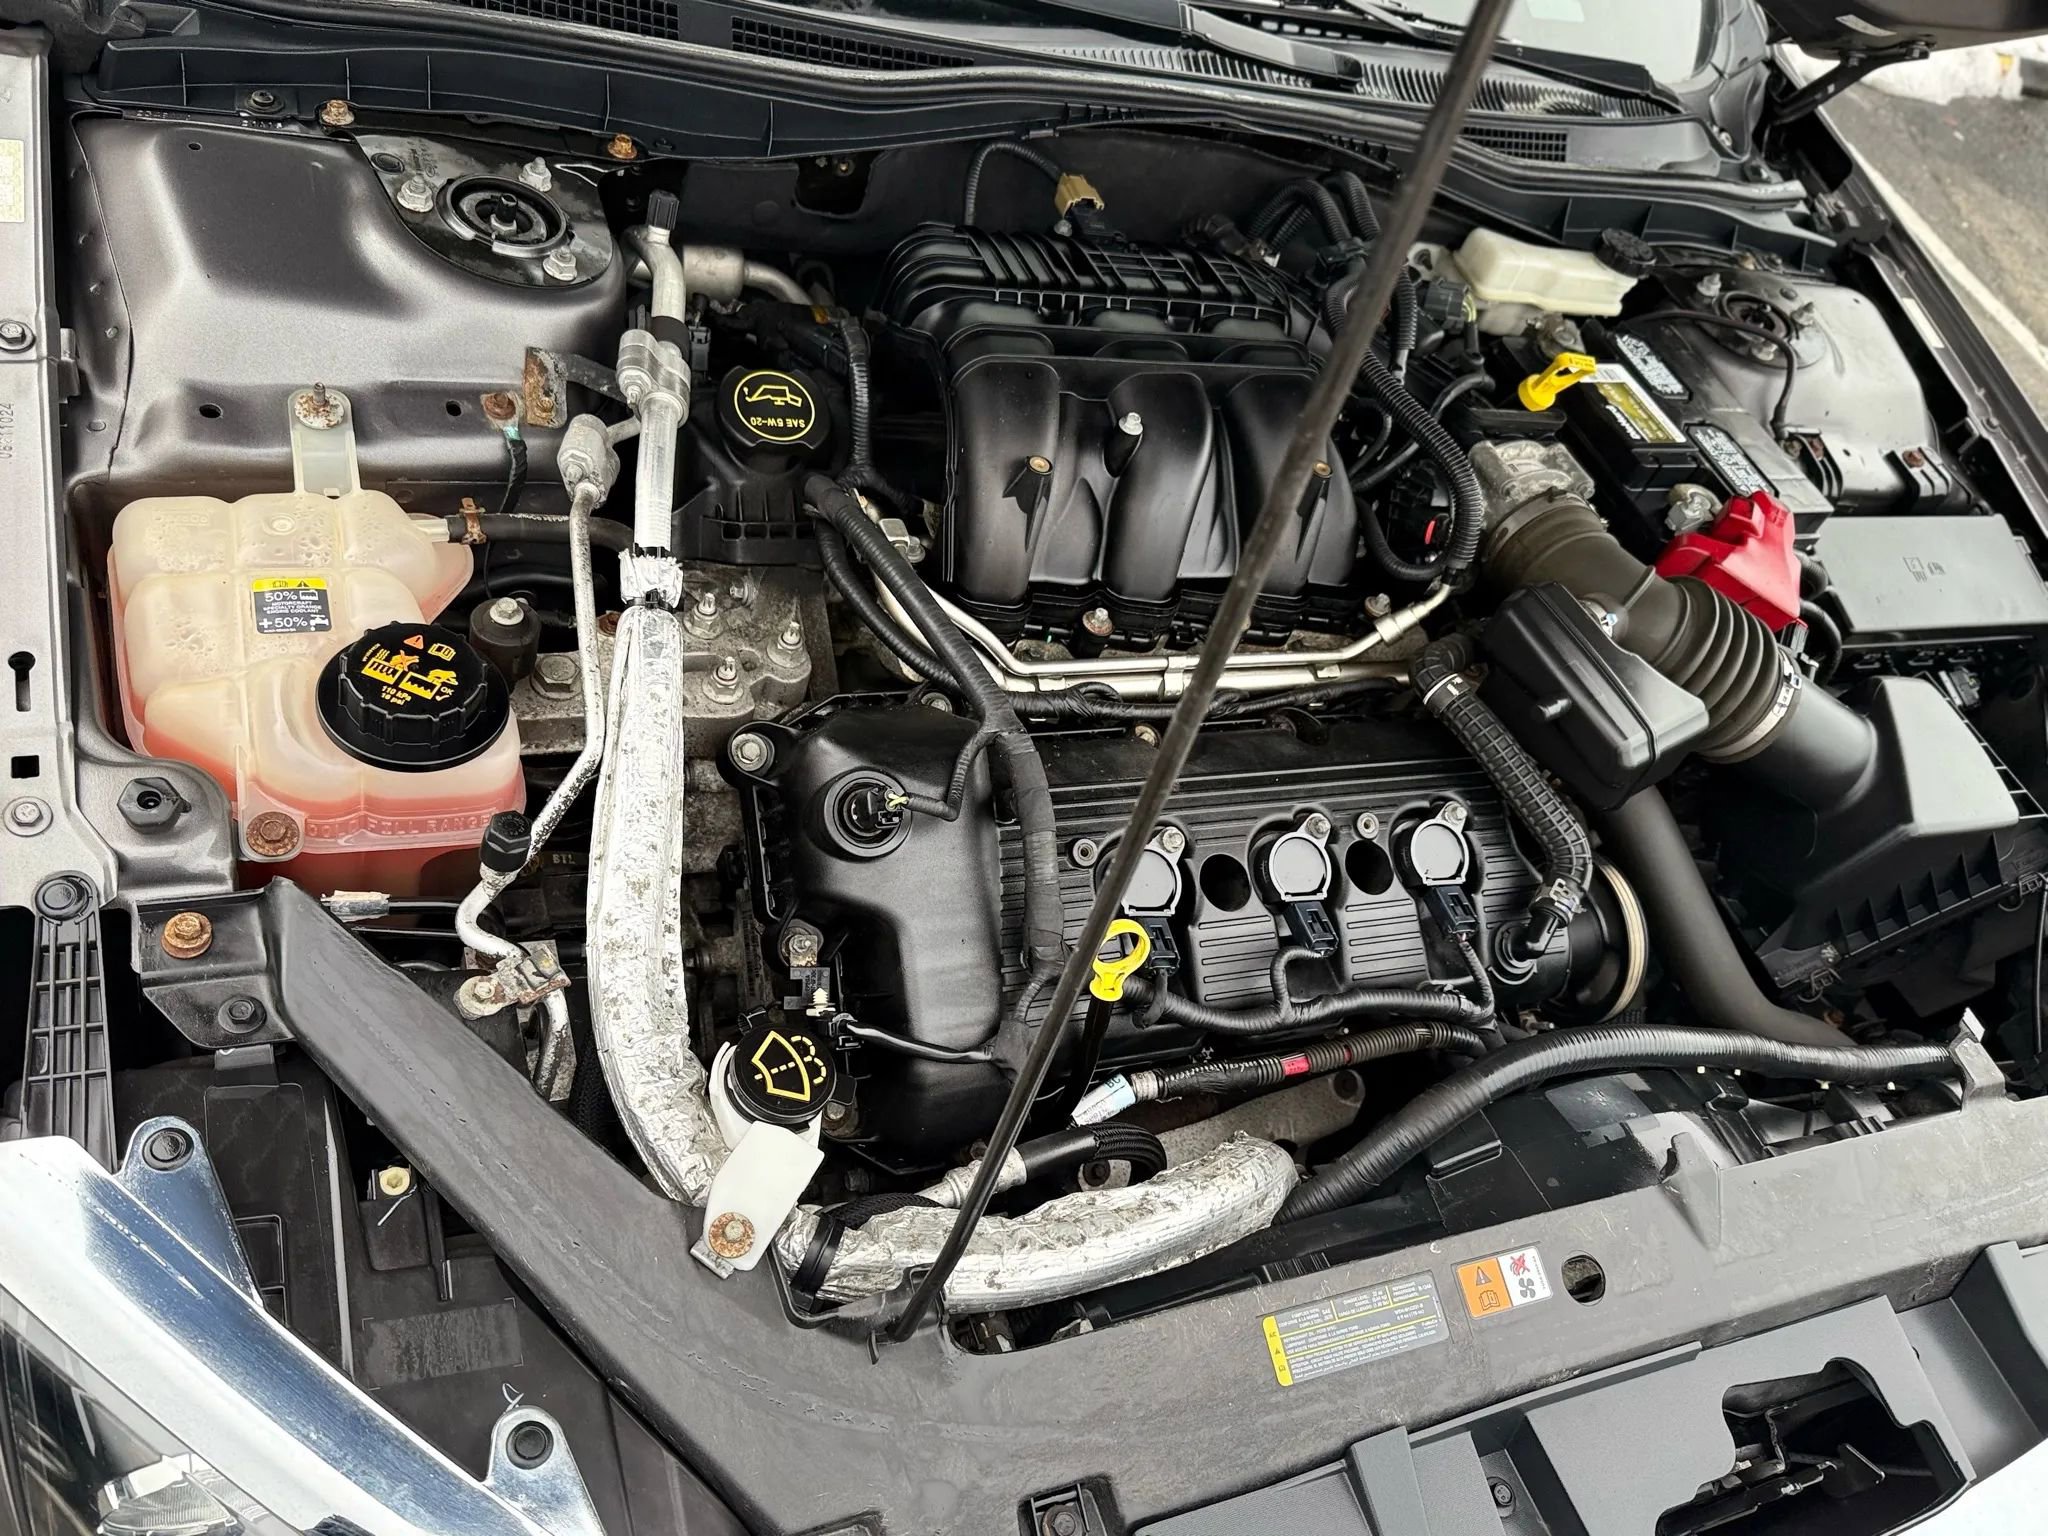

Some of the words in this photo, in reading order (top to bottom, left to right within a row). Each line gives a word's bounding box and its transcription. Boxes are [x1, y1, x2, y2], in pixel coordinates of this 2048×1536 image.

[750, 416, 784, 428] 5W-20
[785, 418, 806, 428] SAE
[264, 591, 298, 602] 50%
[381, 685, 396, 695] 110
[440, 686, 455, 696] OK
[366, 816, 420, 835] FILL
[425, 814, 491, 833] RANGE
